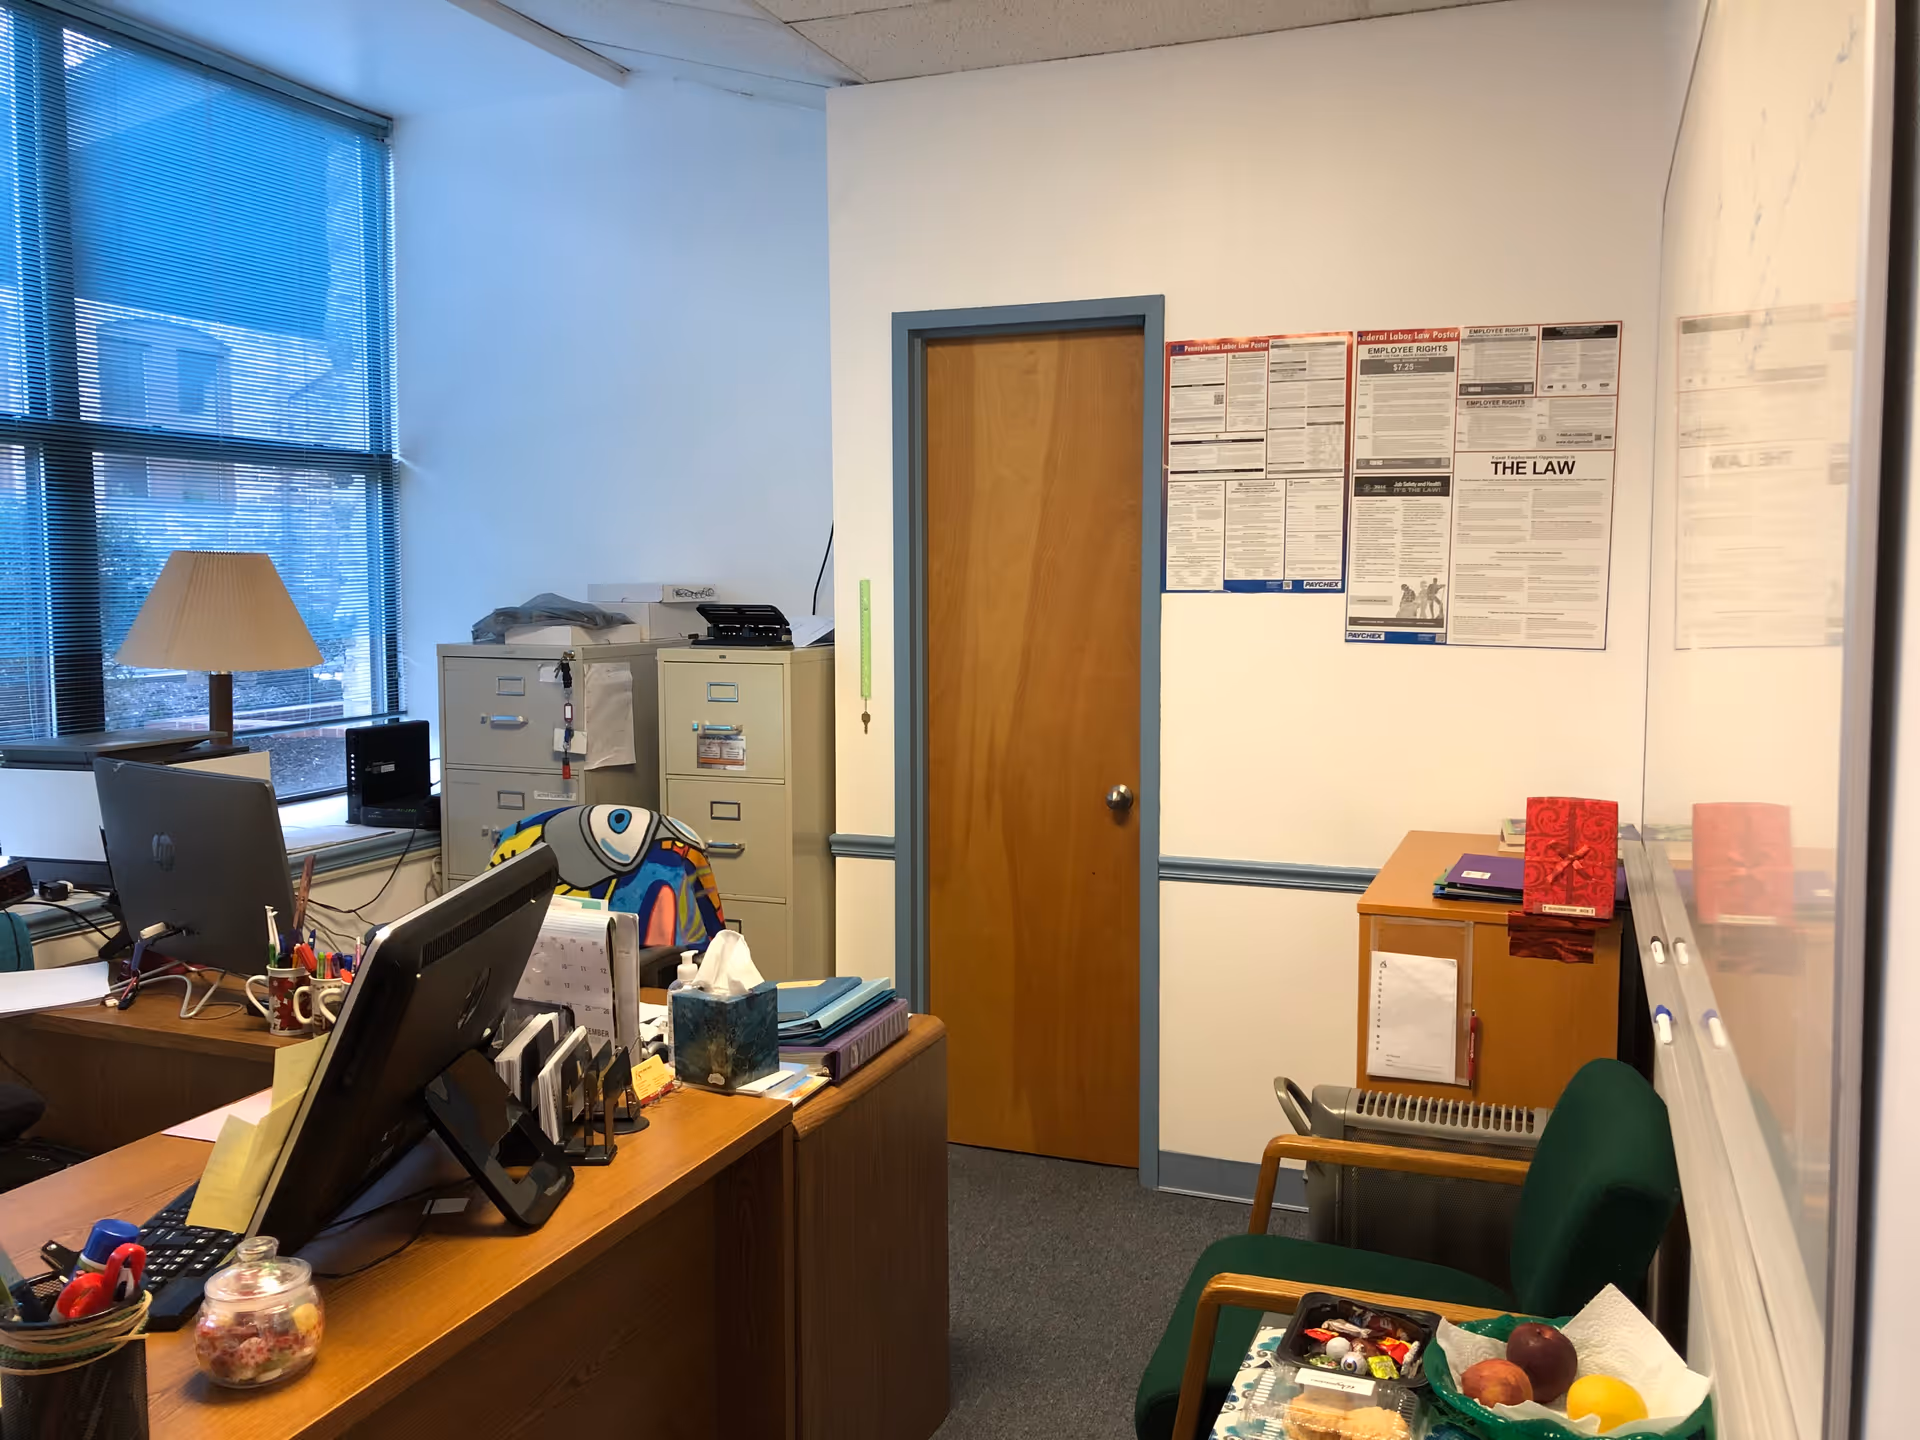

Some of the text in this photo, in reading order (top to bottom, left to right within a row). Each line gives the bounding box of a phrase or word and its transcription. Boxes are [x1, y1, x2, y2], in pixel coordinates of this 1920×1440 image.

[1389, 332, 1412, 340] Labor
[1414, 331, 1430, 340] Law
[1432, 330, 1458, 339] Poster
[1184, 345, 1220, 353] Pennsylvania
[1221, 343, 1237, 351] Labor
[1367, 344, 1448, 355] EMPLOYEE RIGHTS
[1393, 363, 1414, 372] $7.25
[1490, 460, 1576, 476] THE LAW
[1304, 581, 1340, 589] PAYCHEX
[1347, 632, 1383, 640] PAYCHEX
